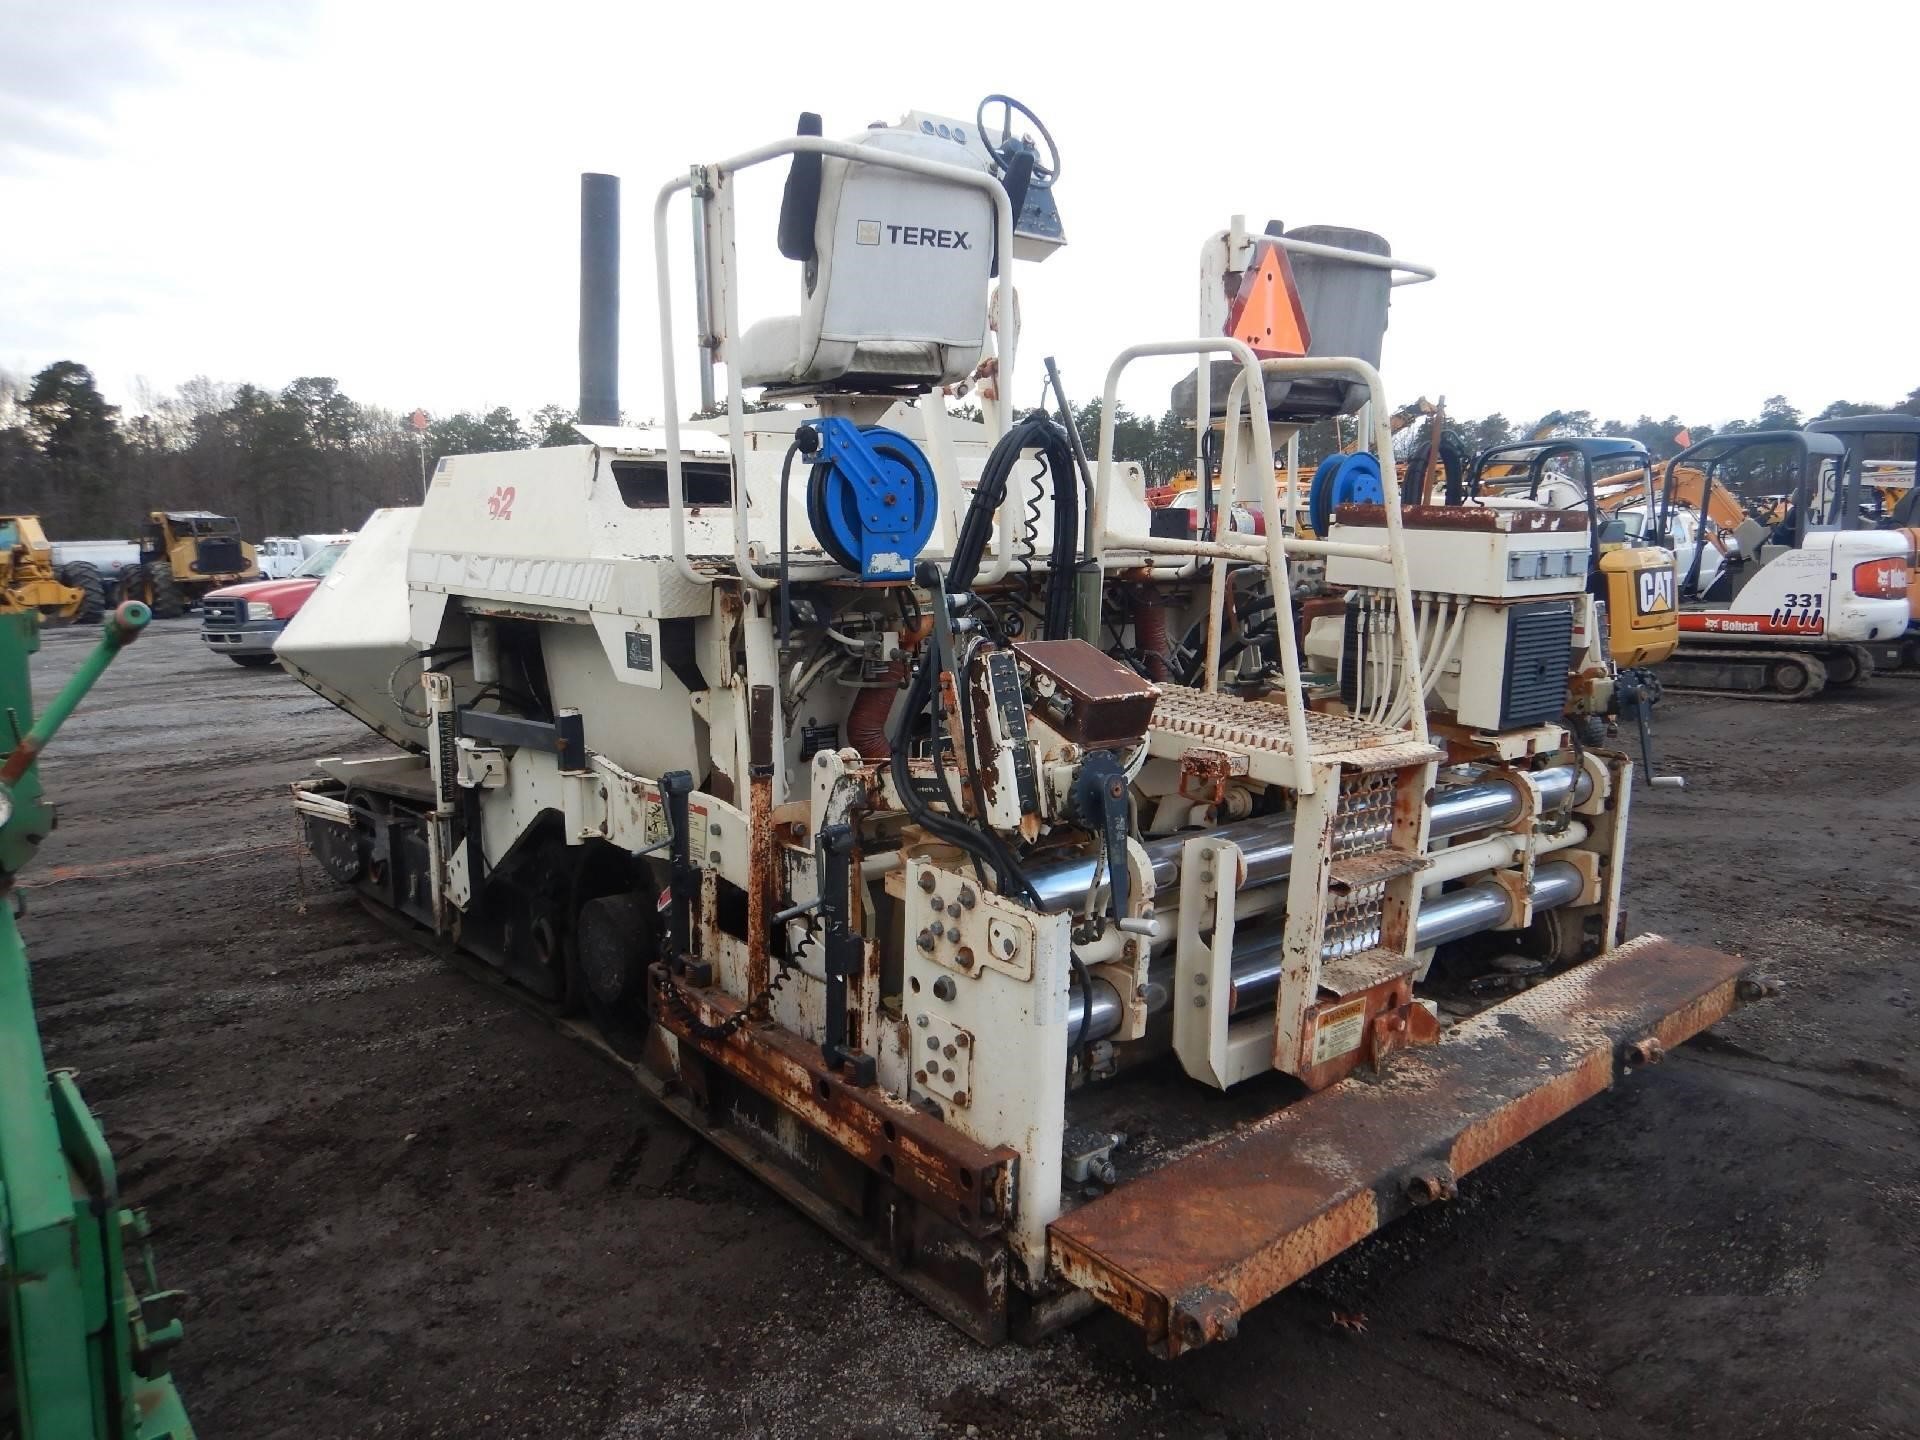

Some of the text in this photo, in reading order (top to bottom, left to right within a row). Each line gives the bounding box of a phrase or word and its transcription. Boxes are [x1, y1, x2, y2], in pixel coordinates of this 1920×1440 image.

[887, 225, 970, 250] TEREX
[1639, 571, 1673, 613] CAT
[1784, 593, 1823, 608] 331
[1722, 620, 1759, 632] Bobcat
